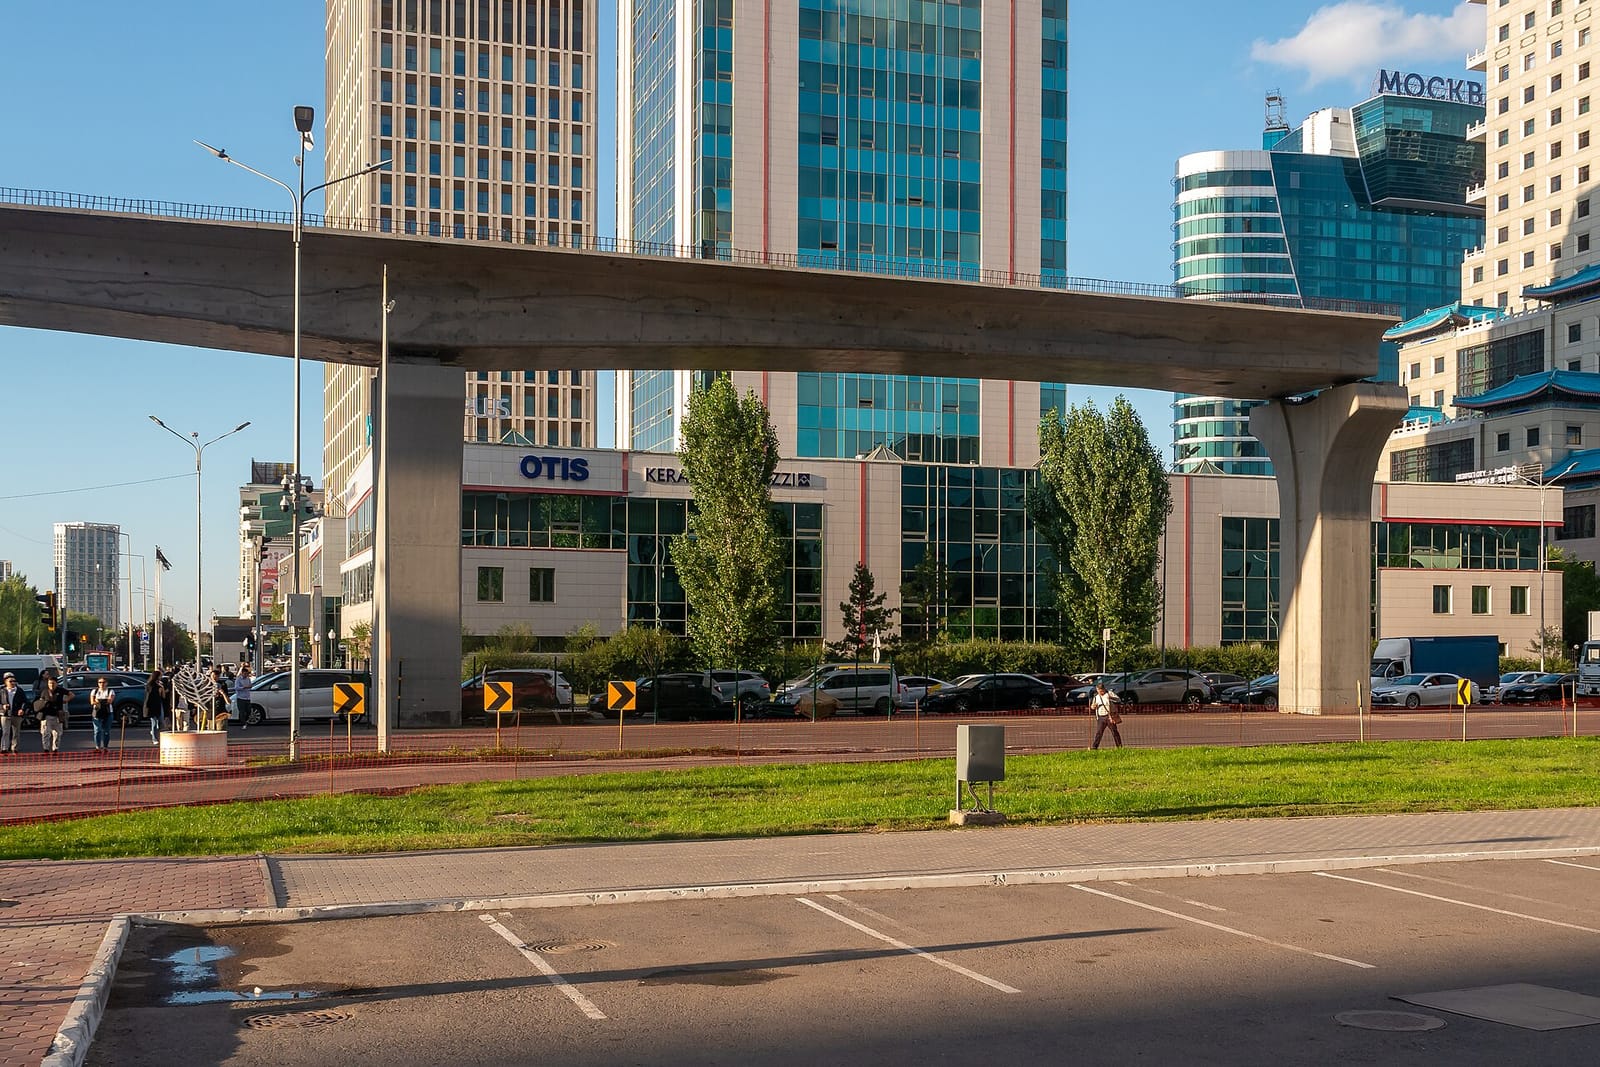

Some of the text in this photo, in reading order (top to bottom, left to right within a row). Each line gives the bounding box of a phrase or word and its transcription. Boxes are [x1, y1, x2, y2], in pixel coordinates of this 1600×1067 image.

[1378, 69, 1485, 105] МОСКВ
[520, 455, 590, 482] OTIS
[645, 467, 796, 487] KERA ZZI
